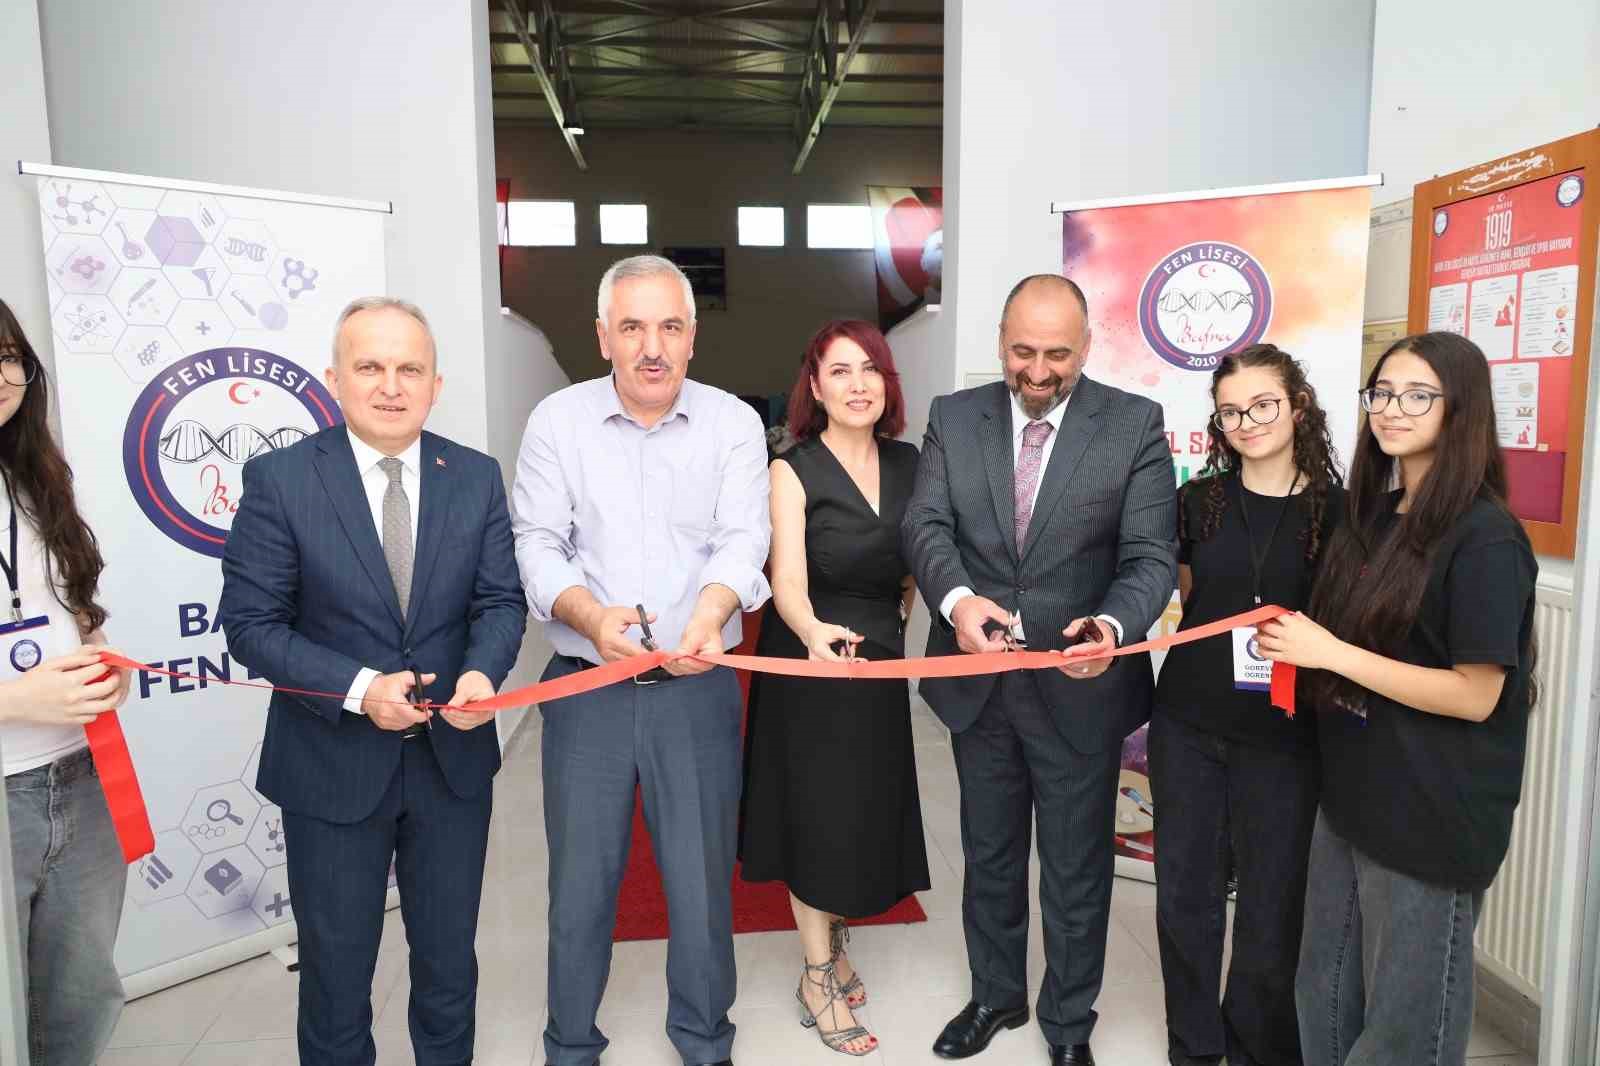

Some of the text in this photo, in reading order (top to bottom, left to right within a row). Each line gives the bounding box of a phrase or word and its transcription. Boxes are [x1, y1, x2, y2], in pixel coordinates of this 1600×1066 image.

[1163, 245, 1249, 275] FEN LİSESİ
[162, 352, 310, 396] FEN LİSESİ
[1186, 354, 1217, 367] 2010
[138, 651, 231, 699] FEN
